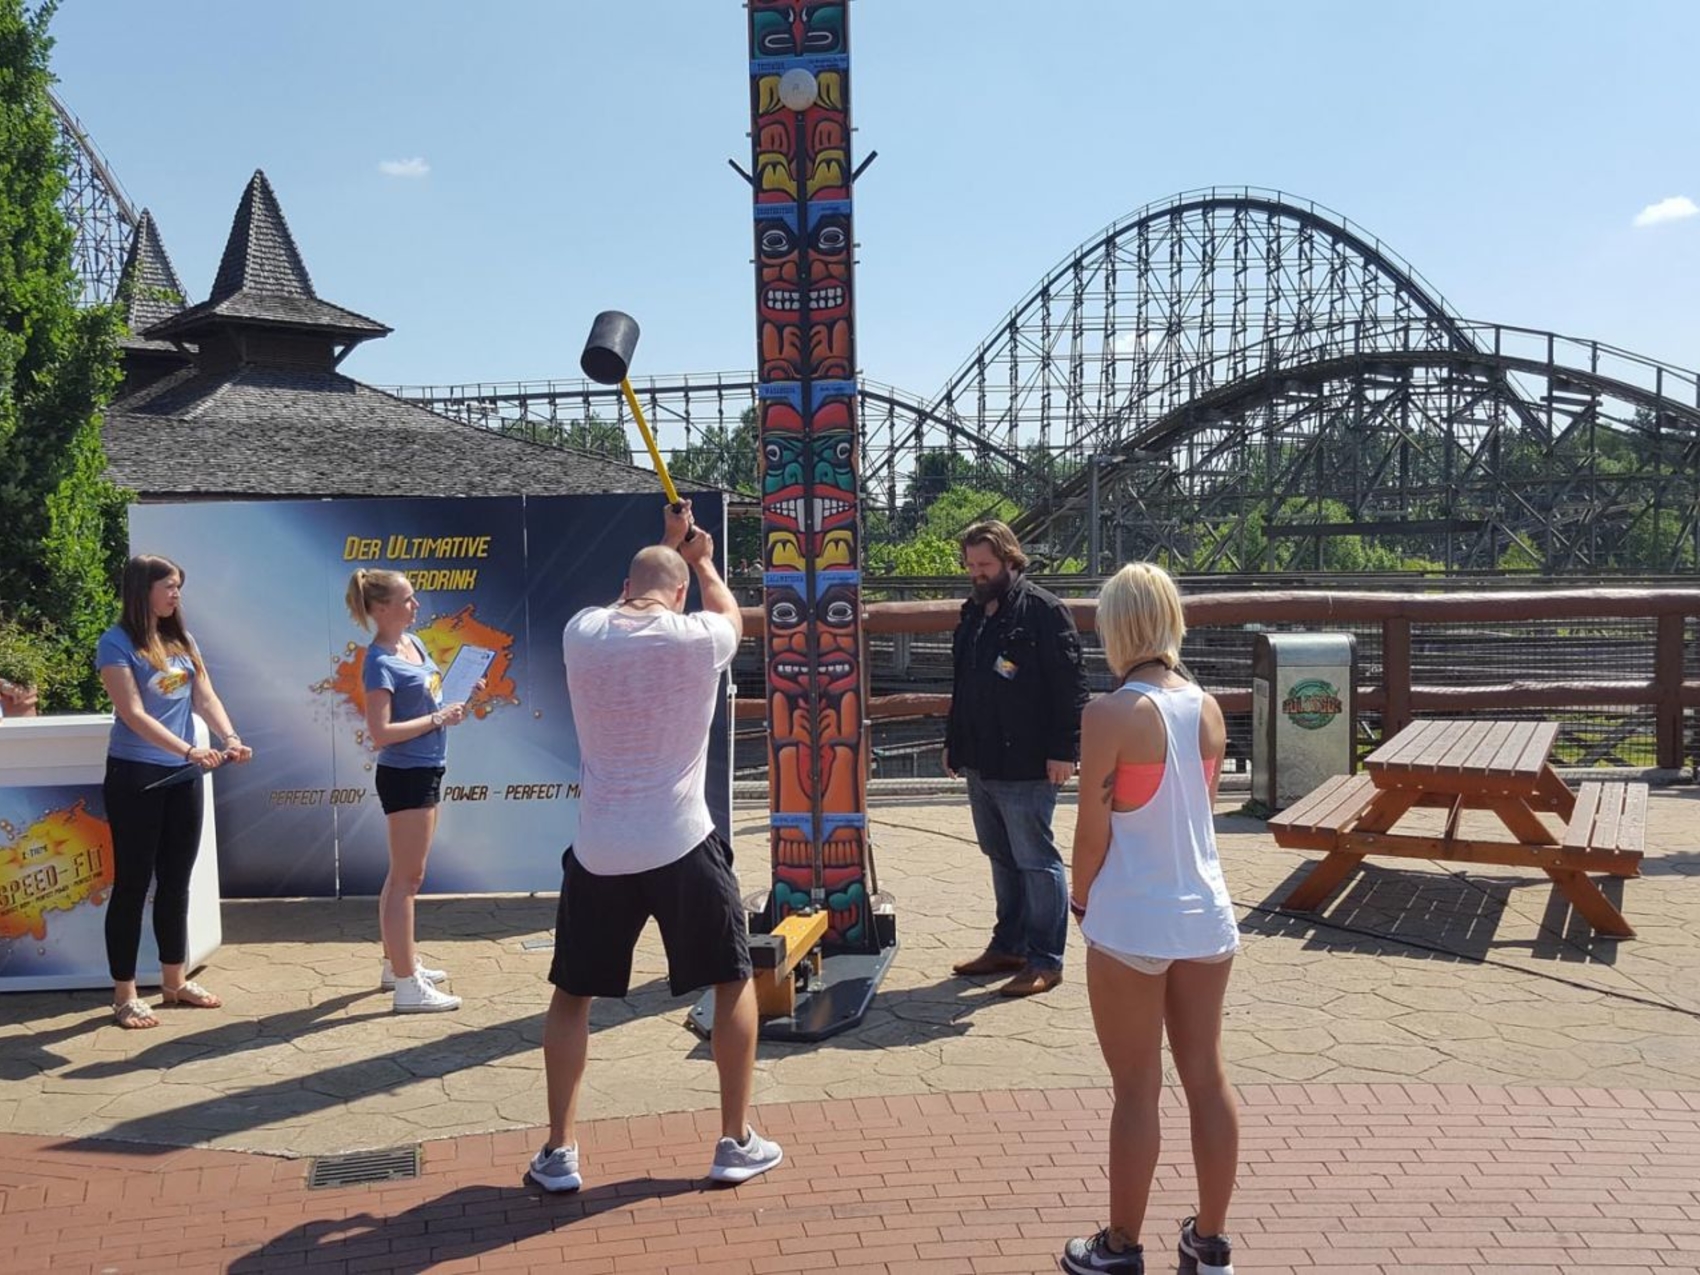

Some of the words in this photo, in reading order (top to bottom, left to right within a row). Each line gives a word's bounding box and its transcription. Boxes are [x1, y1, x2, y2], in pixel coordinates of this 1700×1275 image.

[343, 536, 381, 560] DER
[386, 535, 491, 559] ULTIMATIVE
[270, 789, 326, 805] PERFECT
[329, 788, 367, 804] BODY
[443, 785, 489, 801] POWER
[504, 784, 563, 800] PERFECT
